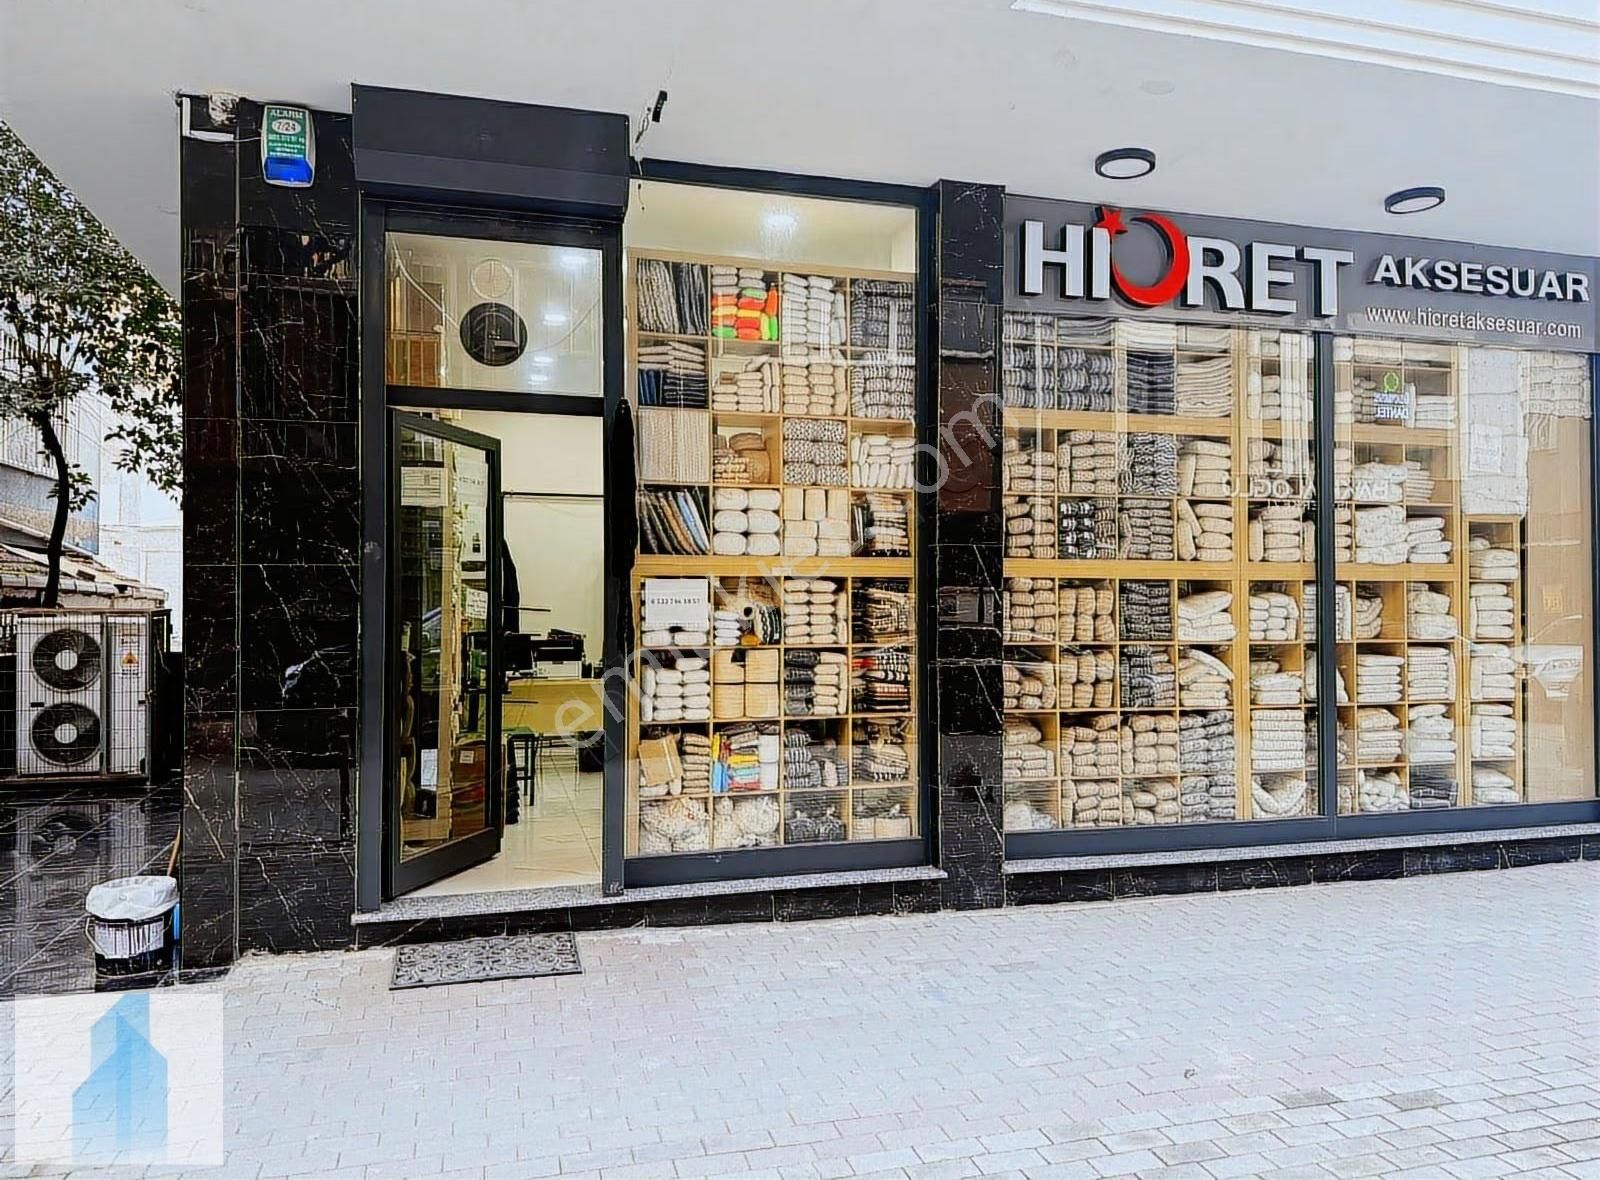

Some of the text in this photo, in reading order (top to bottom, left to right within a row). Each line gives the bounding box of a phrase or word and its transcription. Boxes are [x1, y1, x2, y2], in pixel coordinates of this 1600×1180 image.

[269, 109, 303, 119] ALARM
[1370, 254, 1590, 302] AKSESUAR
[1366, 306, 1582, 340] www.hicretaksesuar.com
